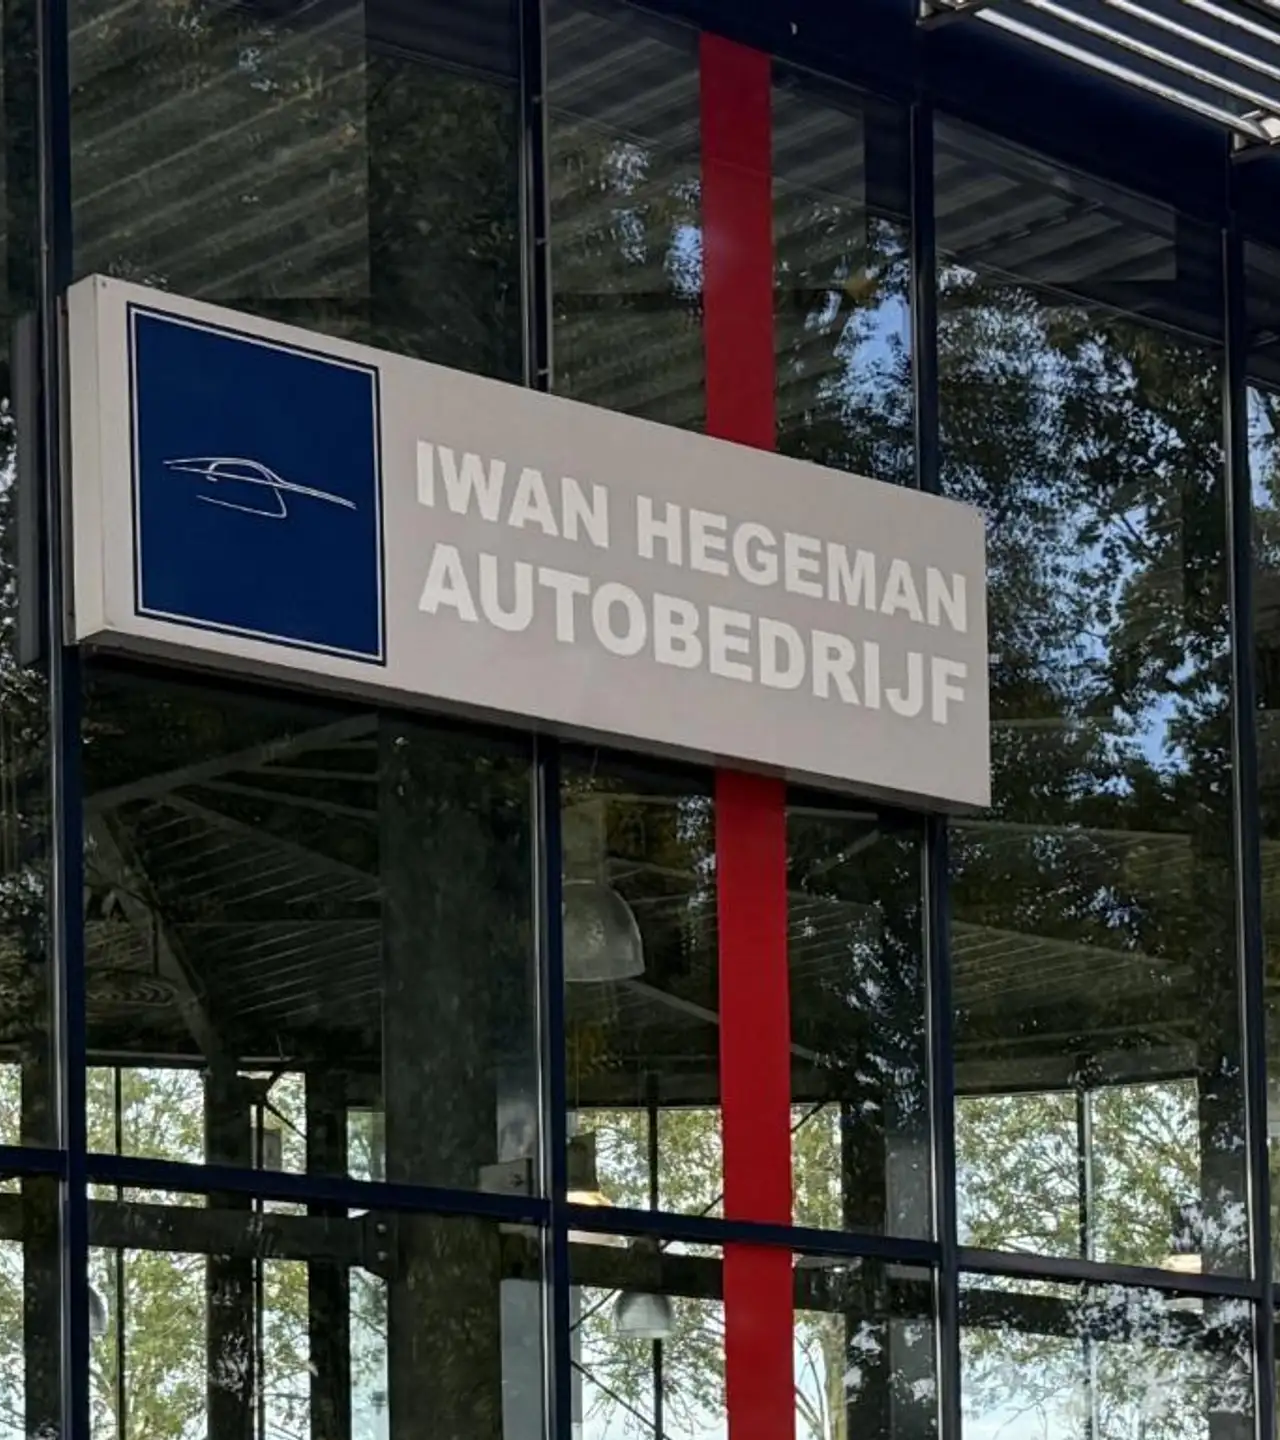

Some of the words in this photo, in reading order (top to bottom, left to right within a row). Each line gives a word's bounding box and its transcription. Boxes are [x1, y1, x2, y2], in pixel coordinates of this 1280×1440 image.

[417, 439, 609, 548] IWAN
[636, 496, 968, 633] HEGEMAN
[419, 542, 968, 725] AUTOBEDRIJF
